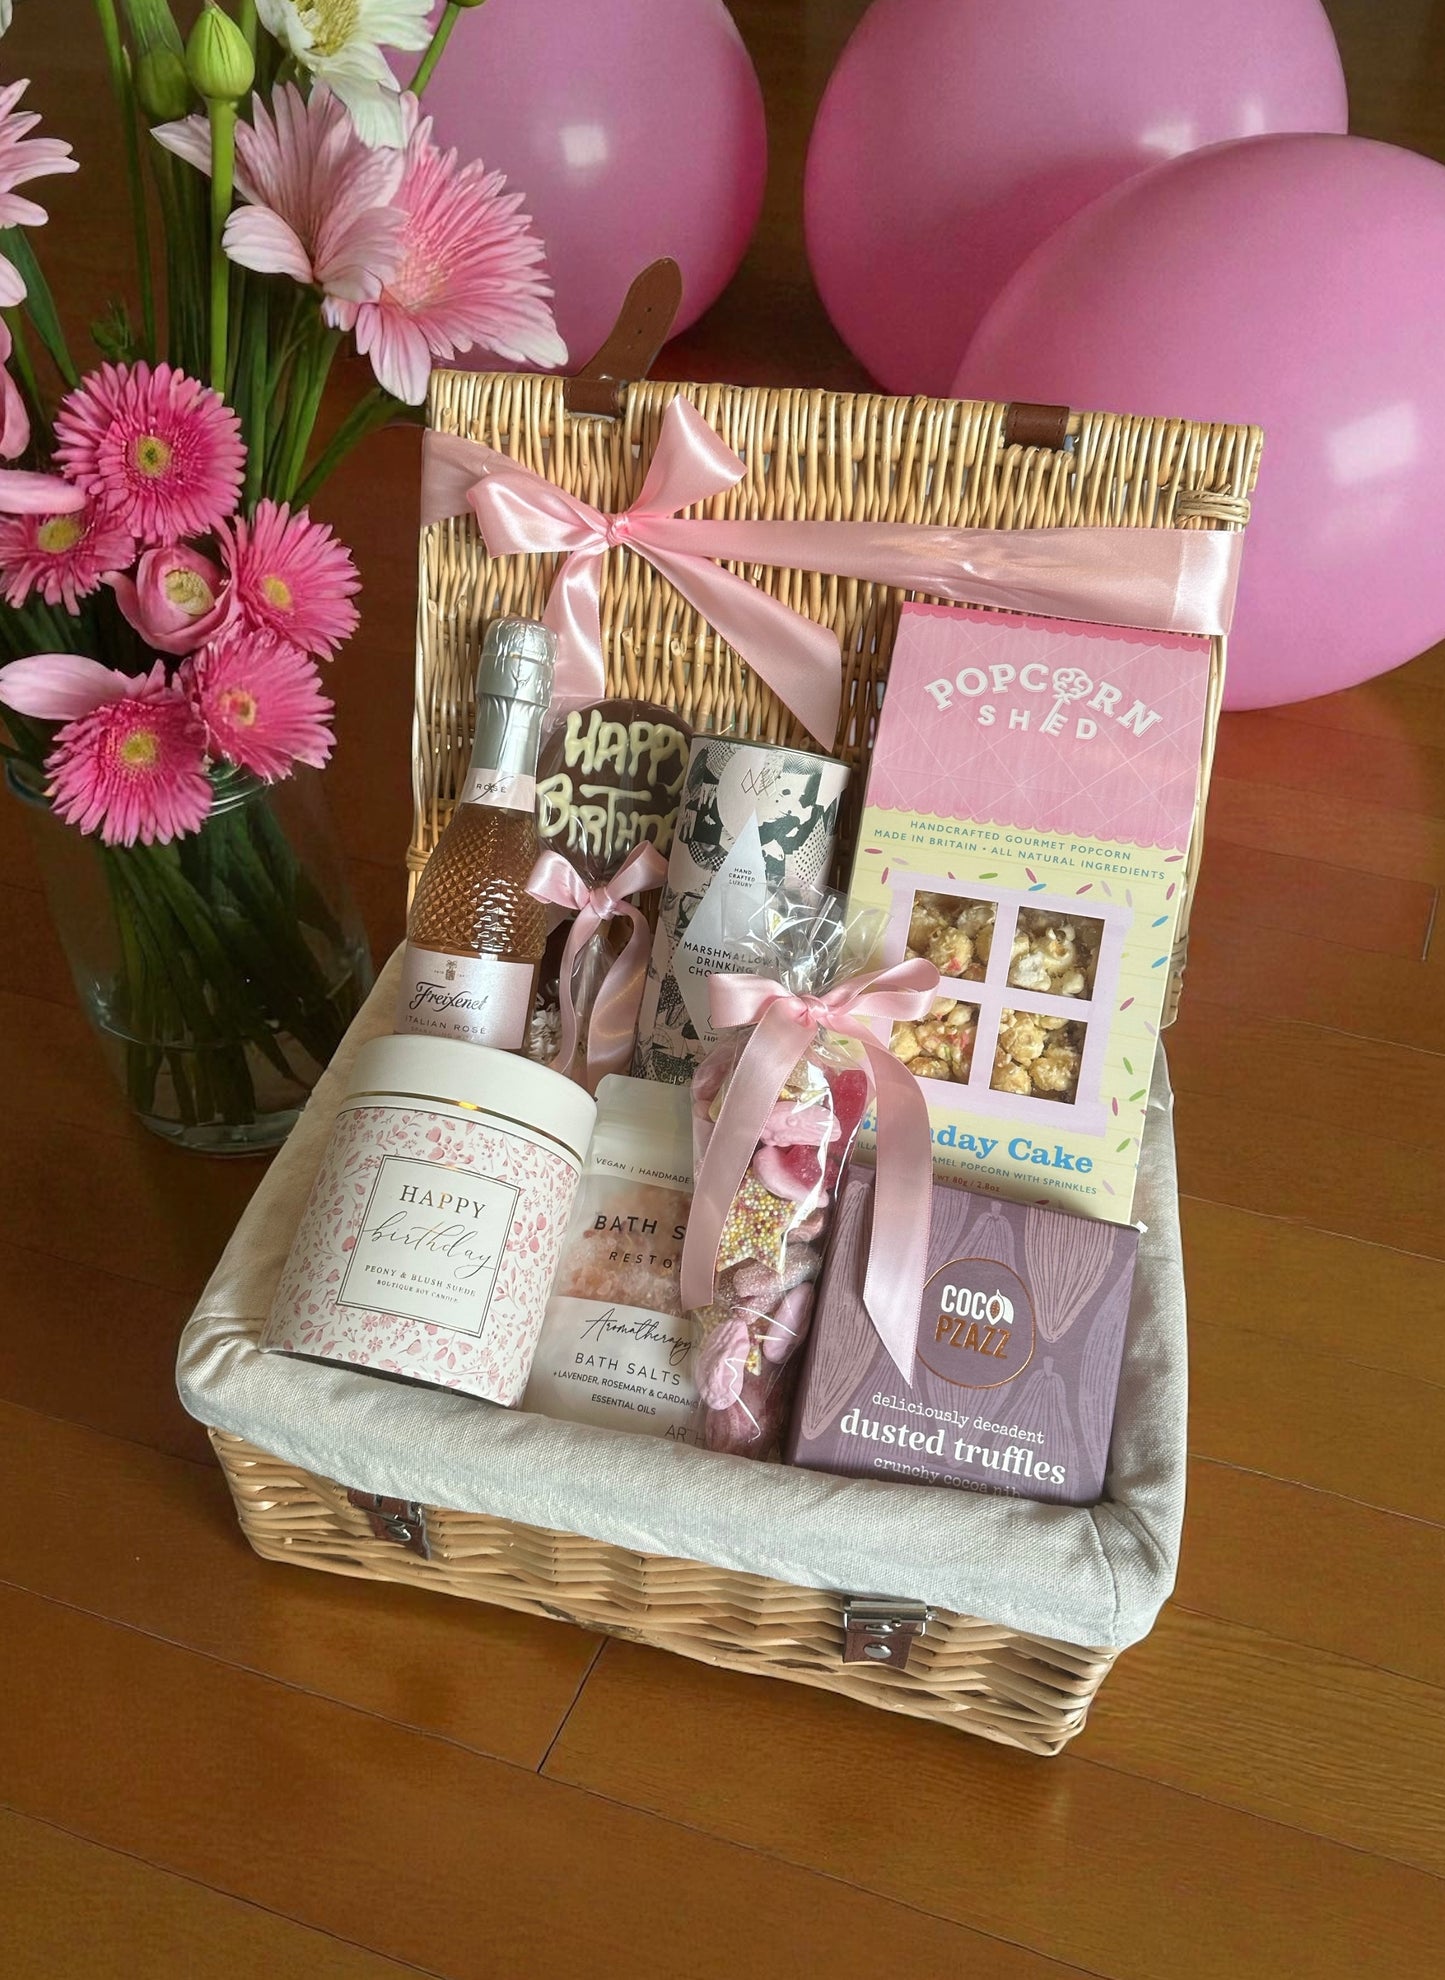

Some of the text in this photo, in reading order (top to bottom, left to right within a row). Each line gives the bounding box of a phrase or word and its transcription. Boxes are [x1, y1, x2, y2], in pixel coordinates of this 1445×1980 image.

[924, 663, 1162, 738] POPCORN
[978, 704, 1098, 740] SHED
[874, 829, 1166, 881] MADE IN BRITAIN ALL NATURAL INGREDIENTS
[910, 820, 1132, 861] HANDCRAFTED GOURMET POPCORN
[729, 873, 755, 882] CRAFTED
[697, 956, 754, 974] DRINKING
[409, 981, 489, 1012] Freixenet
[405, 1015, 447, 1029] ITALIAN
[596, 1157, 626, 1170] VEGAN
[639, 1168, 691, 1184] HANDMADE
[1008, 1138, 1093, 1175] Cake
[961, 1162, 1009, 1178] POPCORN
[1014, 1173, 1040, 1184] WITH
[1043, 1178, 1097, 1195] SPRINKLES
[400, 1184, 486, 1219] HAPPY
[594, 1215, 658, 1235] BATH
[363, 1211, 496, 1279] birthday
[609, 1252, 682, 1273] RESTO
[364, 1264, 397, 1277] PEONY
[411, 1274, 443, 1288] BLUSH
[446, 1283, 476, 1297] SUEDE
[940, 1284, 1015, 1325] COCO
[580, 1308, 693, 1366] Aromatherapy
[934, 1314, 1012, 1360] PZAZZ
[575, 1352, 681, 1386] BATH SALTS
[591, 1394, 656, 1416] ESSENTIAL OILS
[601, 1378, 648, 1396] ROSEMARY
[648, 1389, 655, 1397] &
[872, 1392, 1045, 1445] deliciously decadent
[840, 1408, 1067, 1486] dusted truffles
[873, 1457, 940, 1484] crunchy
[943, 1473, 988, 1493] cocoa
